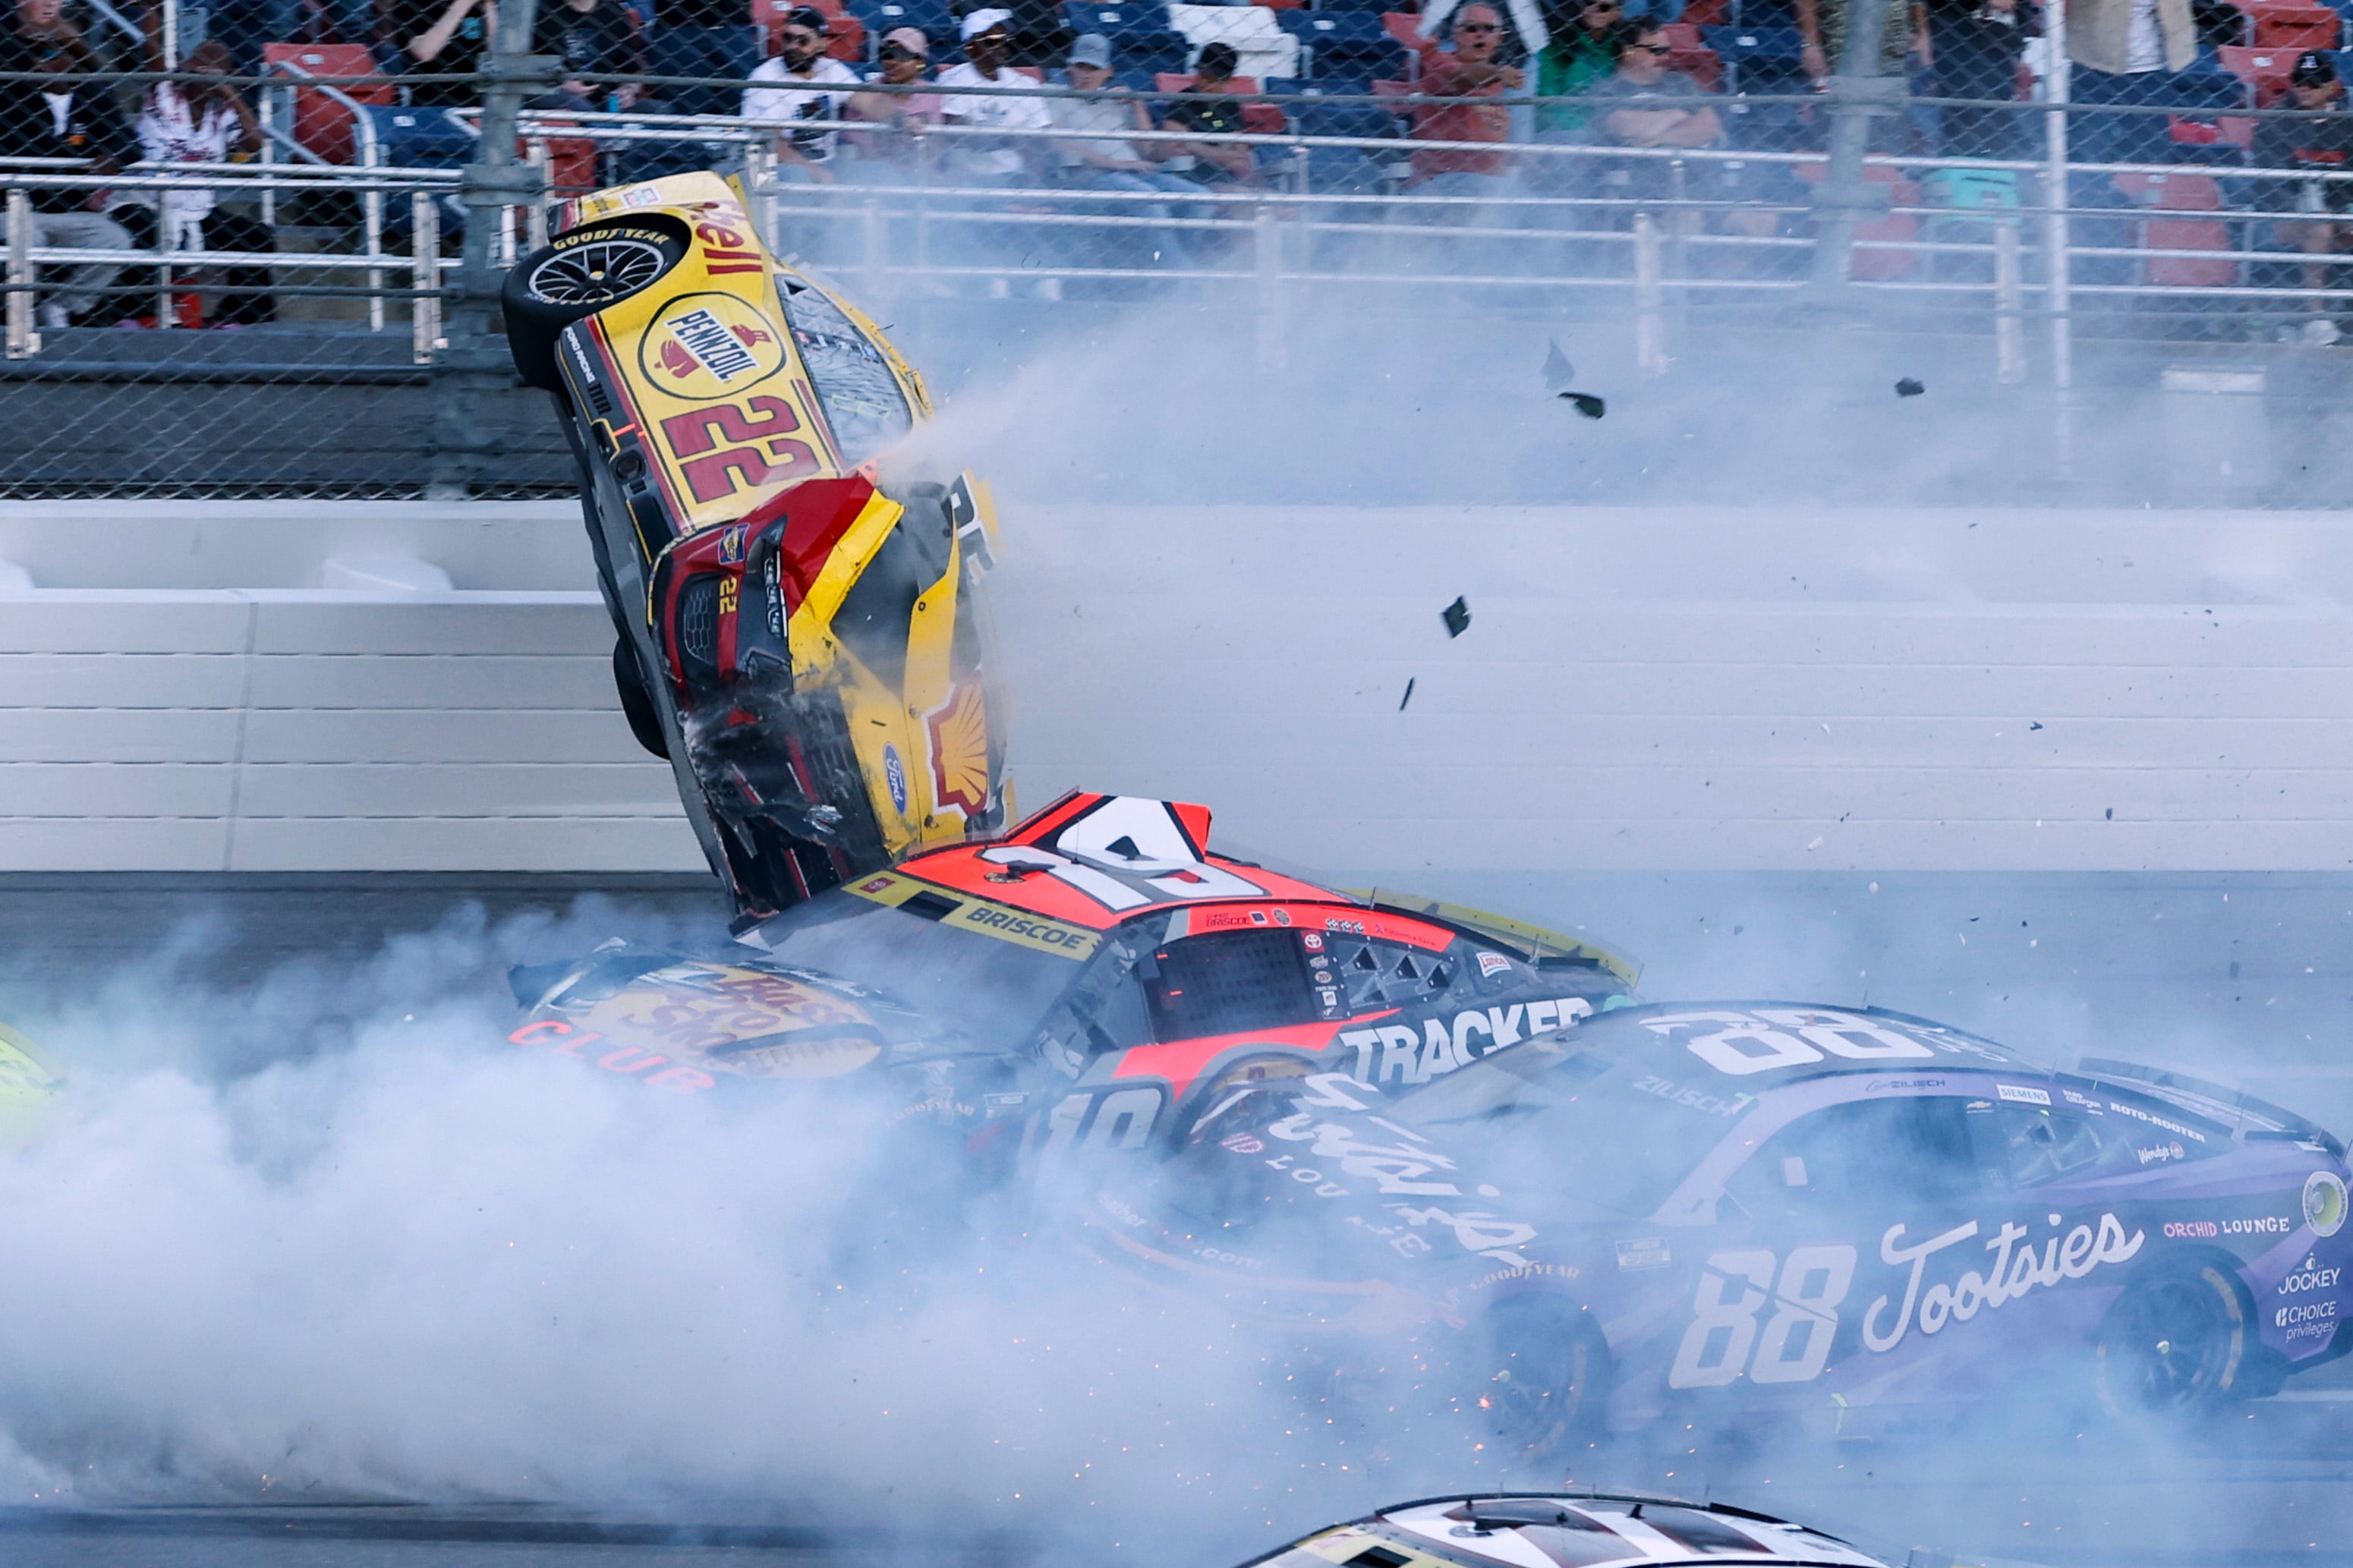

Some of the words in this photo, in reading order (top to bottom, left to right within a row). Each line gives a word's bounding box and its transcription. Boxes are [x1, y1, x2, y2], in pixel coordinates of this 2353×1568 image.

[563, 326, 582, 352] FORD
[575, 349, 597, 385] RACING
[666, 310, 758, 382] PENNZOIL
[660, 395, 821, 505] 22
[719, 577, 738, 616] 22
[886, 758, 904, 804] Ford
[966, 907, 1088, 949] BRISCOE
[1205, 917, 1250, 927] BRISCOE
[509, 1020, 717, 1094] CLUB
[1637, 1009, 1935, 1075] 88
[1633, 1075, 1749, 1117] ZILISCH
[2001, 1086, 2047, 1102] SIEMENS
[2110, 1102, 2205, 1143] ROTO-ROOTER
[1265, 1154, 1432, 1258] LOUE
[2163, 1220, 2218, 1239] ORCHID
[2222, 1217, 2290, 1234] LOUNGE
[1863, 1212, 2145, 1353] Tootsies
[2279, 1267, 2341, 1295] JOCKEY
[1669, 1244, 1857, 1390] 88
[2285, 1321, 2336, 1343] privileges
[2288, 1301, 2337, 1324] CHOICE
